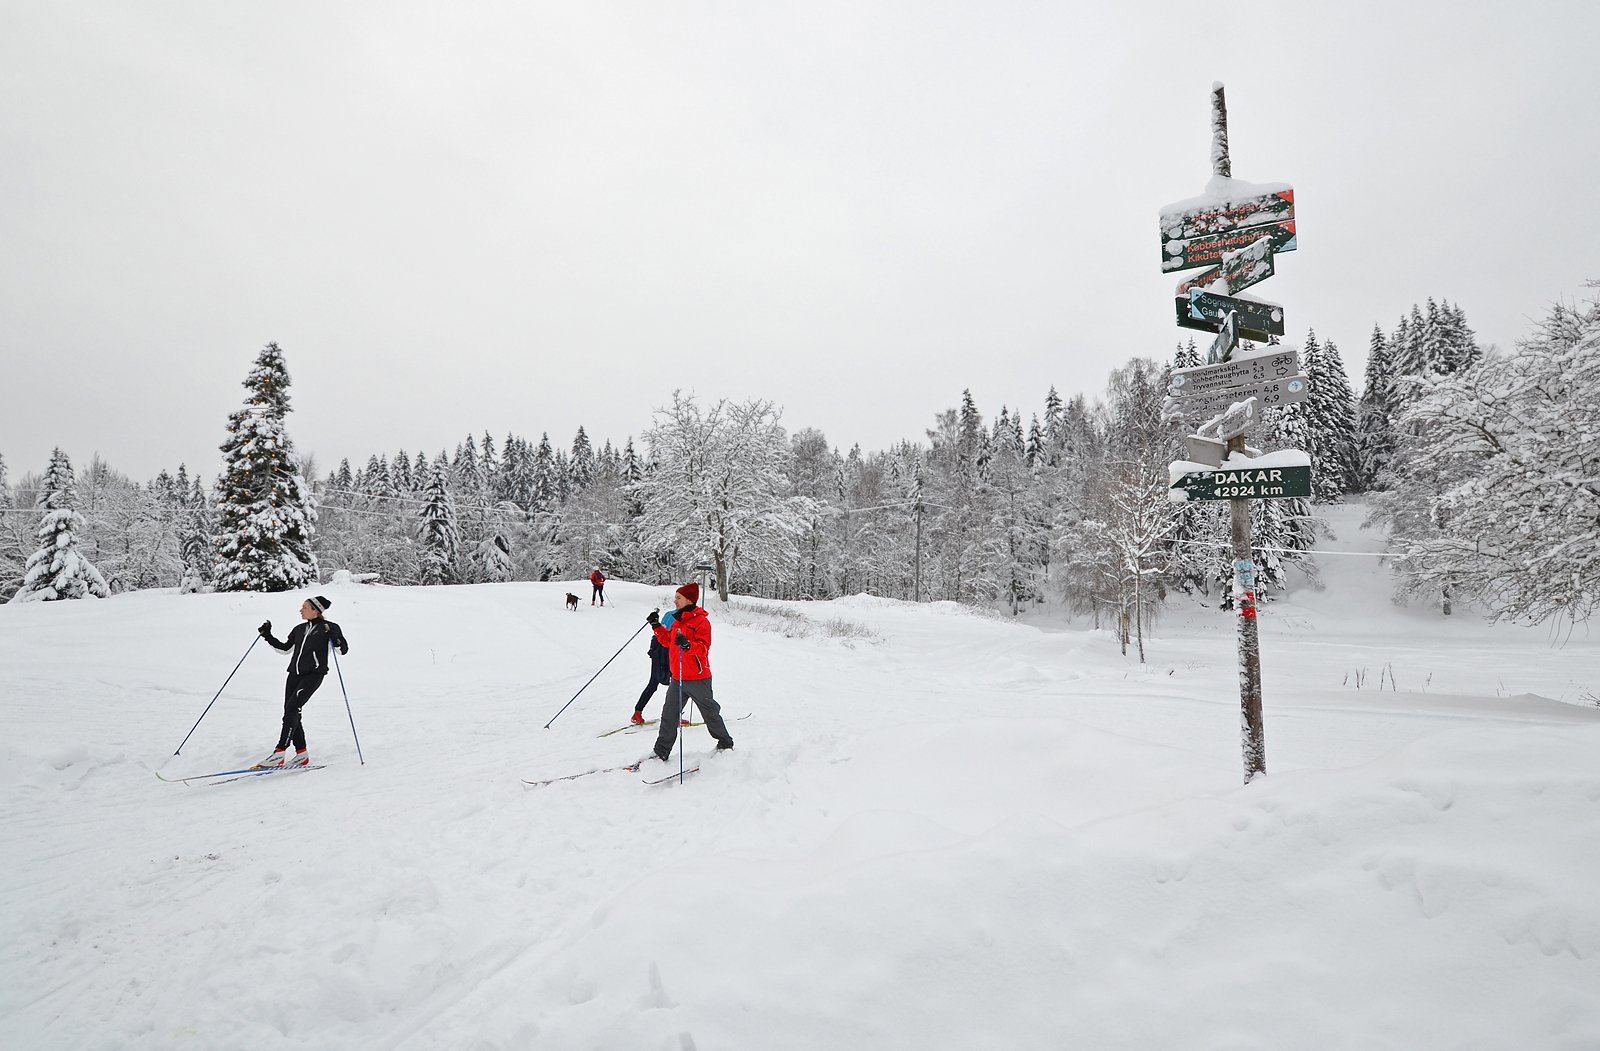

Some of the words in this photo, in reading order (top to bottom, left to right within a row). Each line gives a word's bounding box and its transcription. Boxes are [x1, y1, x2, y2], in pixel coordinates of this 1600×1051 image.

[1263, 384, 1280, 394] 4,8
[1264, 394, 1280, 404] 6,9
[1215, 469, 1283, 485] DAKAR
[1260, 485, 1284, 496] km
